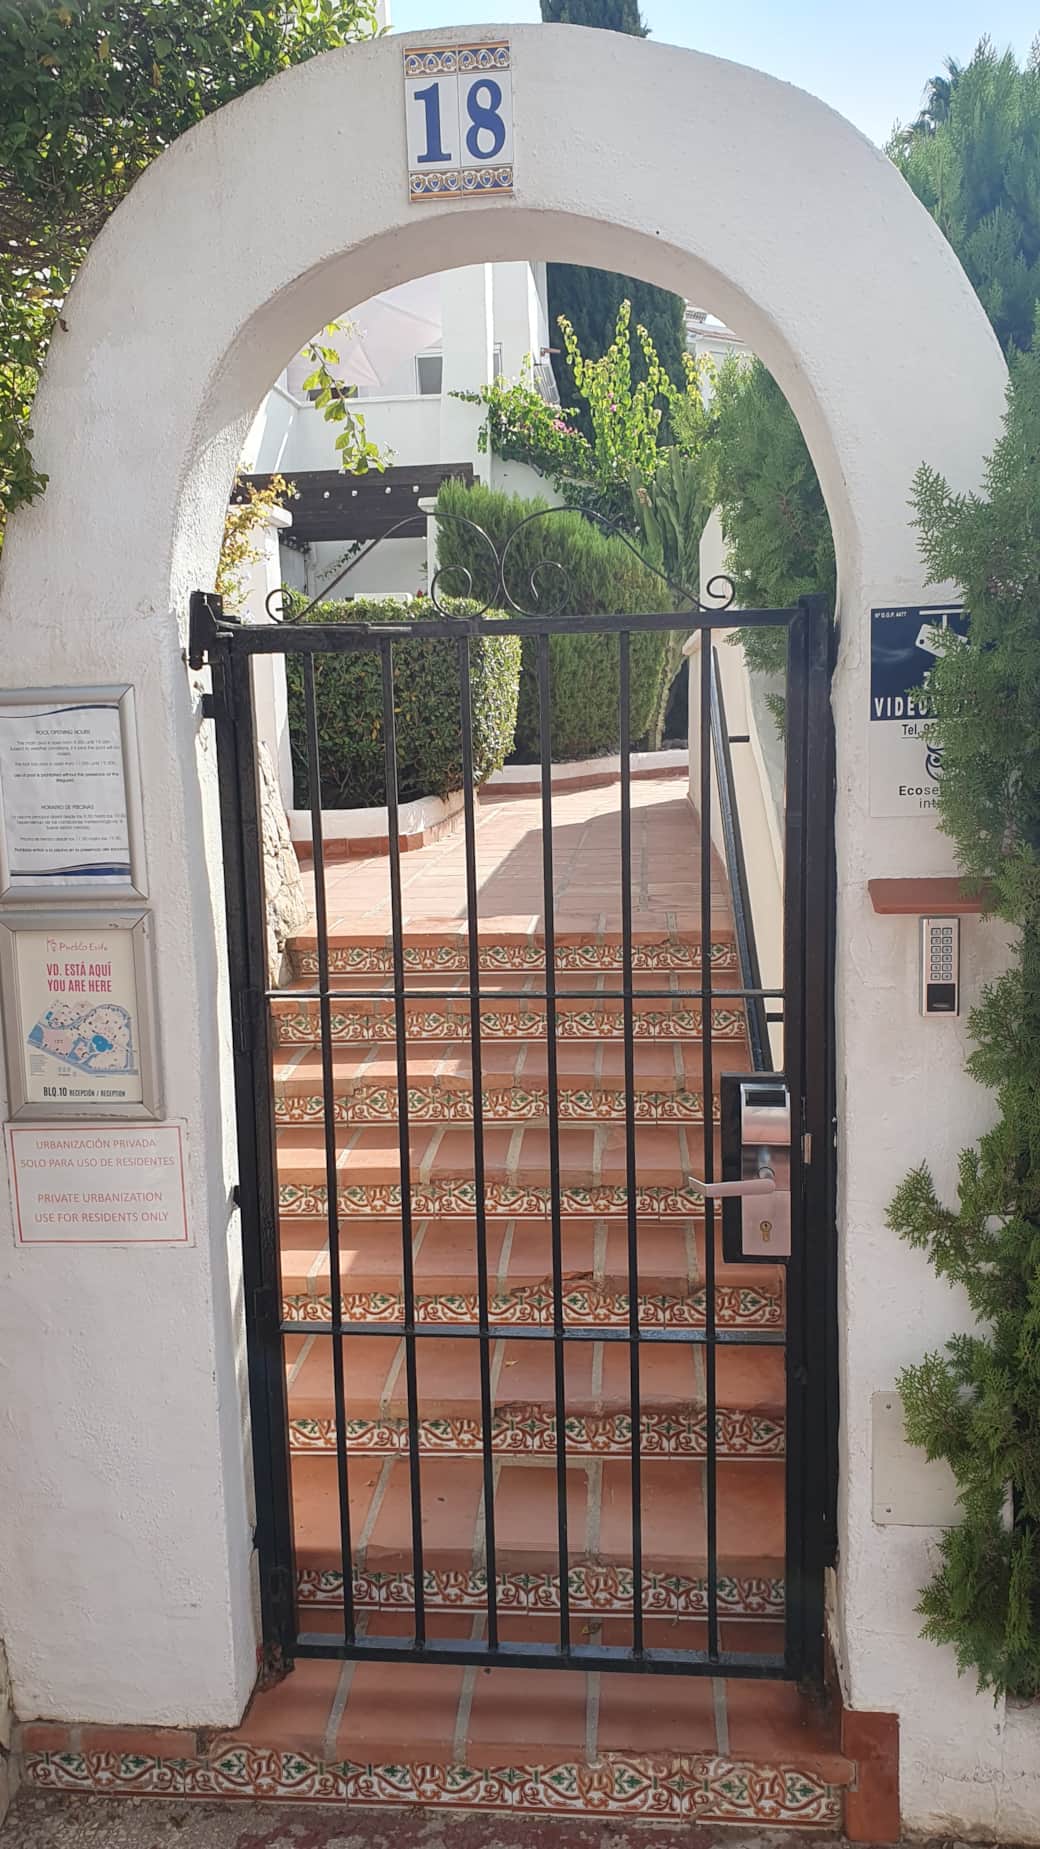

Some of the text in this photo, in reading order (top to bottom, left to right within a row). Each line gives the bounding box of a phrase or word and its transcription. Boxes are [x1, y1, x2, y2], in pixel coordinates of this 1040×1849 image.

[414, 79, 506, 163] 18
[874, 696, 929, 717] VIDEO
[901, 723, 920, 736] Tel.
[899, 785, 939, 796] Ecose
[919, 798, 937, 808] int
[47, 960, 112, 977] VD. ESTÁ AQUÍ
[47, 979, 112, 992] YOU ARE HERE
[36, 1138, 156, 1150] URBANIZACIÓN PRIVADA
[21, 1156, 175, 1168] SOLO PARA USO DE RESIDENTES
[38, 1191, 162, 1203] PRIVATE URBANIZATION
[35, 1211, 169, 1223] USE FOR RESIDENTS ONLY
